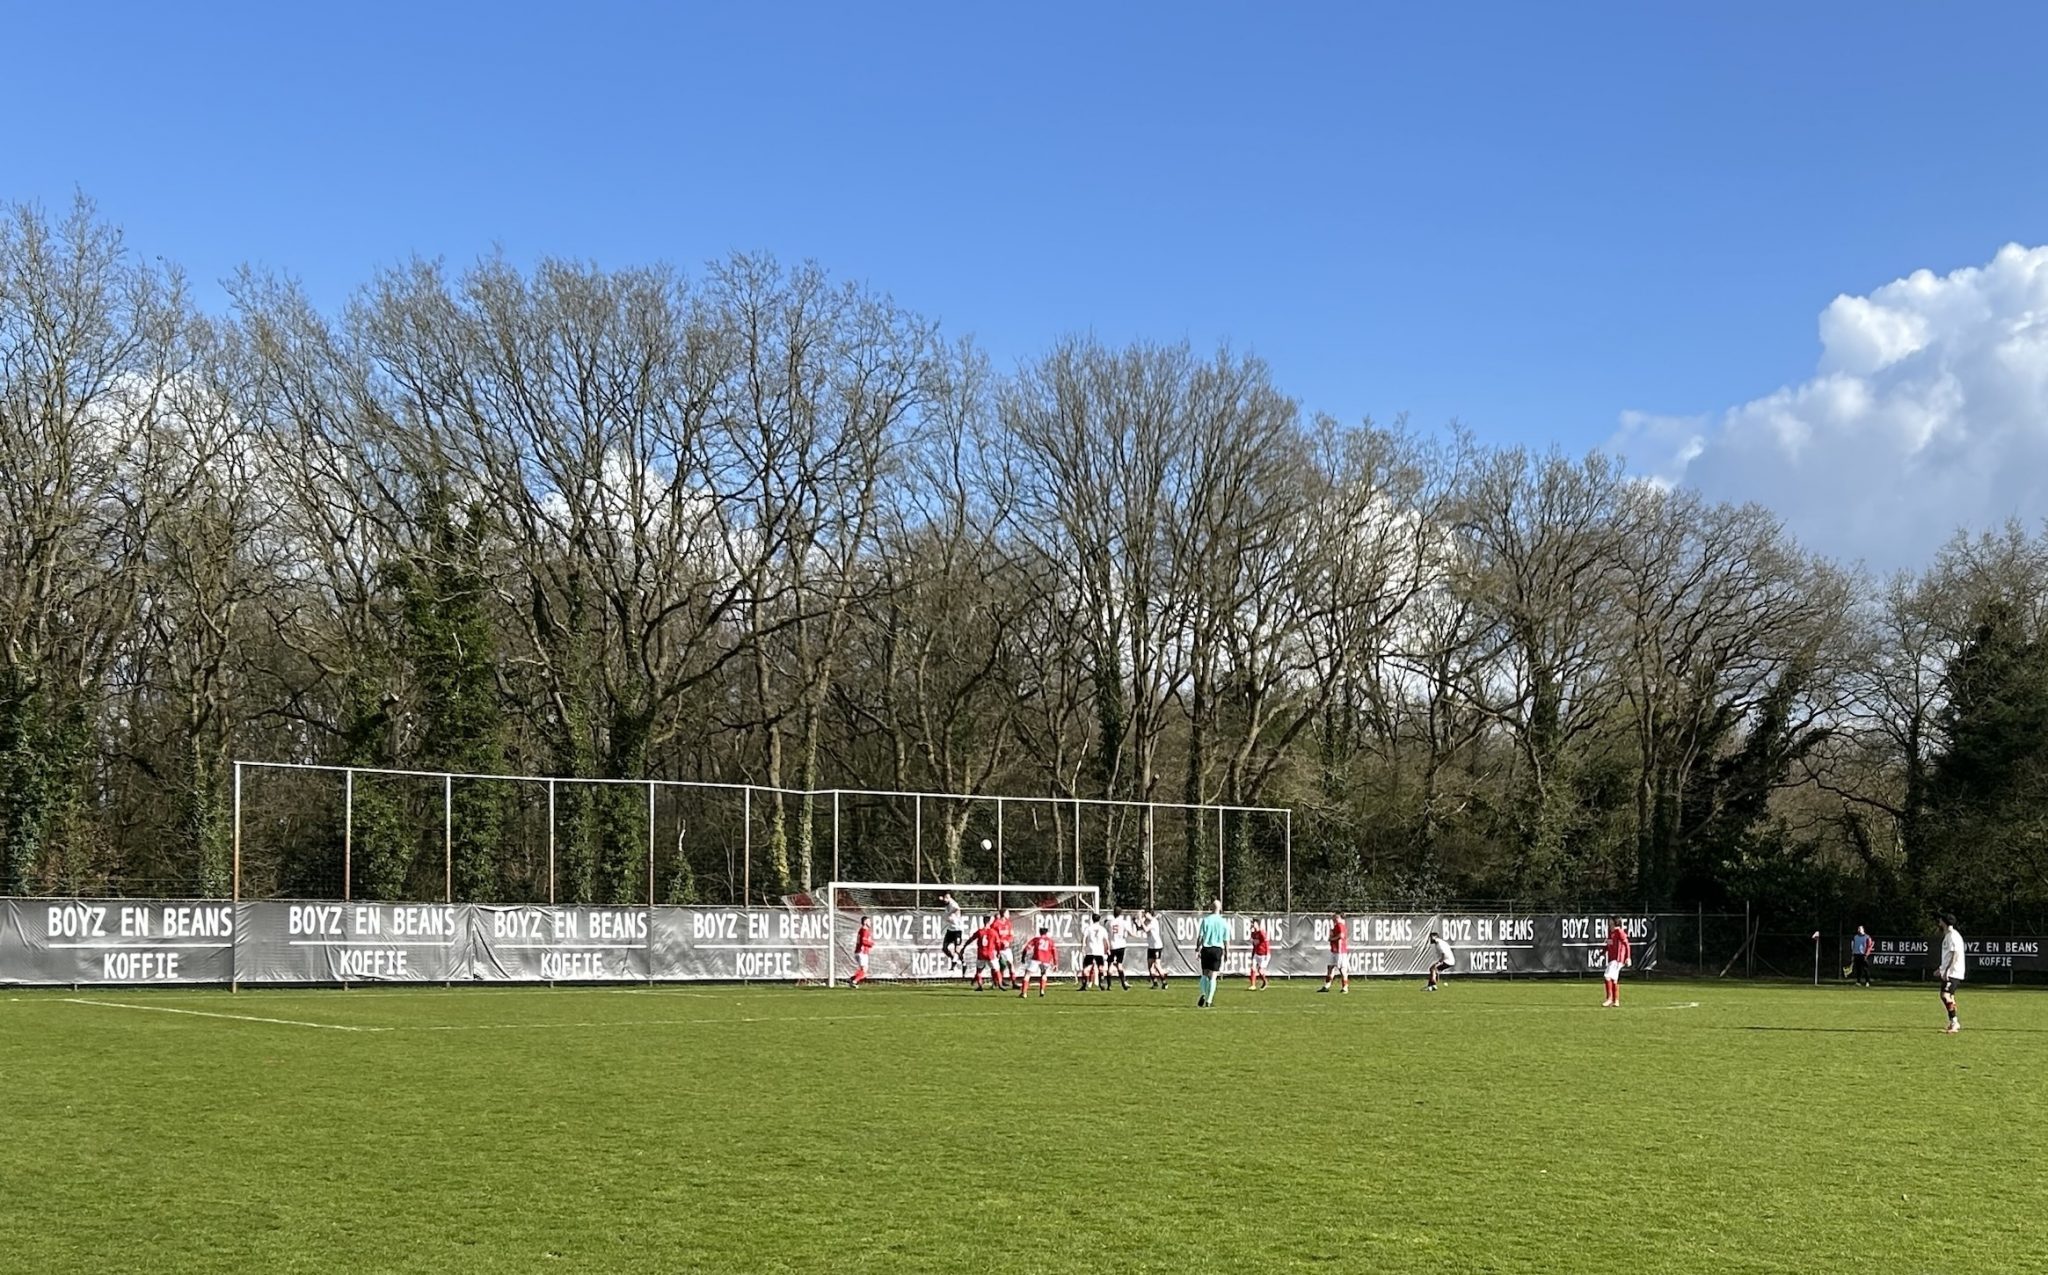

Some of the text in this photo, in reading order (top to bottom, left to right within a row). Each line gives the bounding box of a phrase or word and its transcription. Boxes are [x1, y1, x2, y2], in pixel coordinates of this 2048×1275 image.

[48, 907, 232, 937] BOYZ EN BEANS
[289, 906, 455, 936] BOYZ EN BEANS
[494, 911, 648, 939] BOYZ EN BEANS
[693, 913, 829, 940] BOYZ EN BEANS
[872, 915, 913, 940] BOYZ
[922, 915, 941, 940] EN
[1177, 917, 1201, 941] BOY
[1314, 919, 1412, 941] BO EN BEANS
[1442, 919, 1534, 941] BOYZ EN BEANS
[1562, 918, 1647, 939] BOYZ EN EANS
[982, 934, 989, 947] 6
[1881, 941, 1893, 951] EN
[1899, 941, 1929, 952] BEANS
[1965, 942, 2038, 953] YZ EN BEANS
[104, 953, 179, 979] KOFFIE
[340, 951, 407, 976] KOFFIE
[541, 953, 602, 977] KOFFIE
[736, 952, 792, 976] KOFFIE
[1470, 951, 1508, 971] KOFFIE
[1873, 955, 1905, 965] KOFFIE
[1979, 957, 2012, 967] KOFFIE
